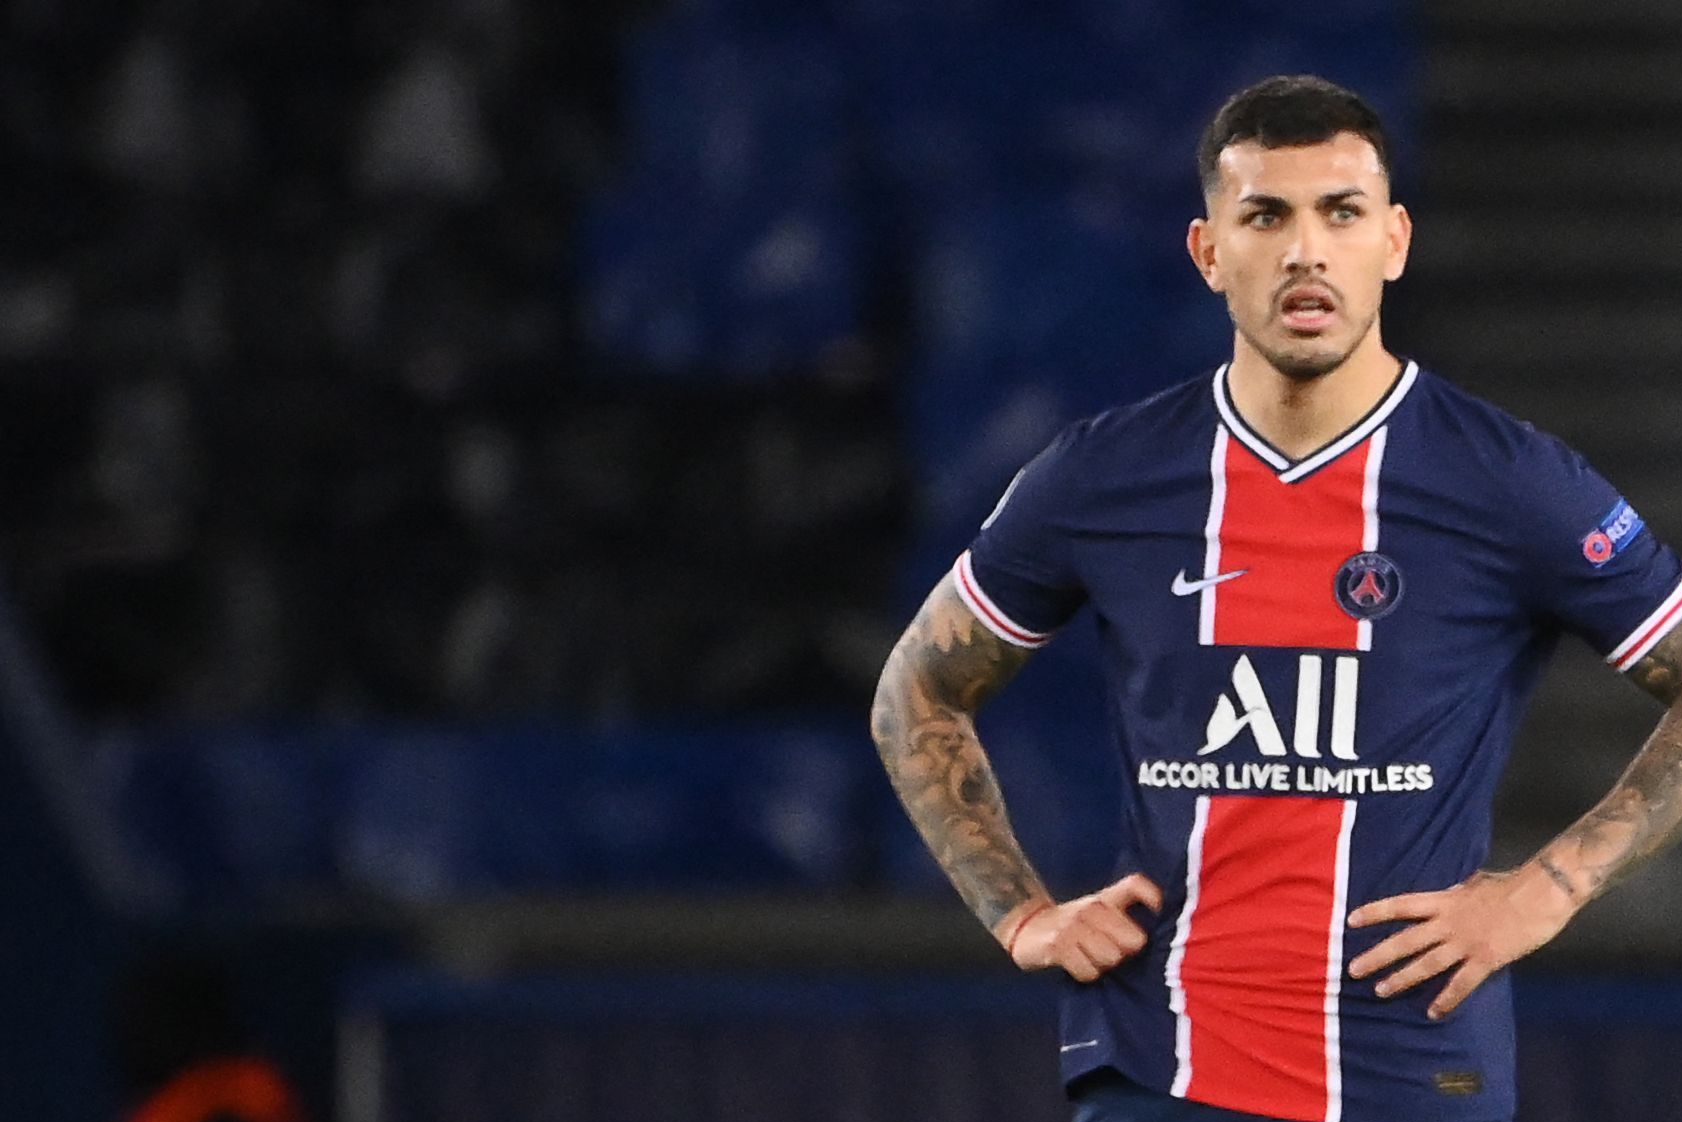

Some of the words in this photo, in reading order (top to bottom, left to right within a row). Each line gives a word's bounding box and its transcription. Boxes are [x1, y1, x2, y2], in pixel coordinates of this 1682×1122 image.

[1138, 761, 1220, 789] ACCOR
[1225, 763, 1291, 790] LIVE
[1296, 763, 1434, 794] LIMITLESS
